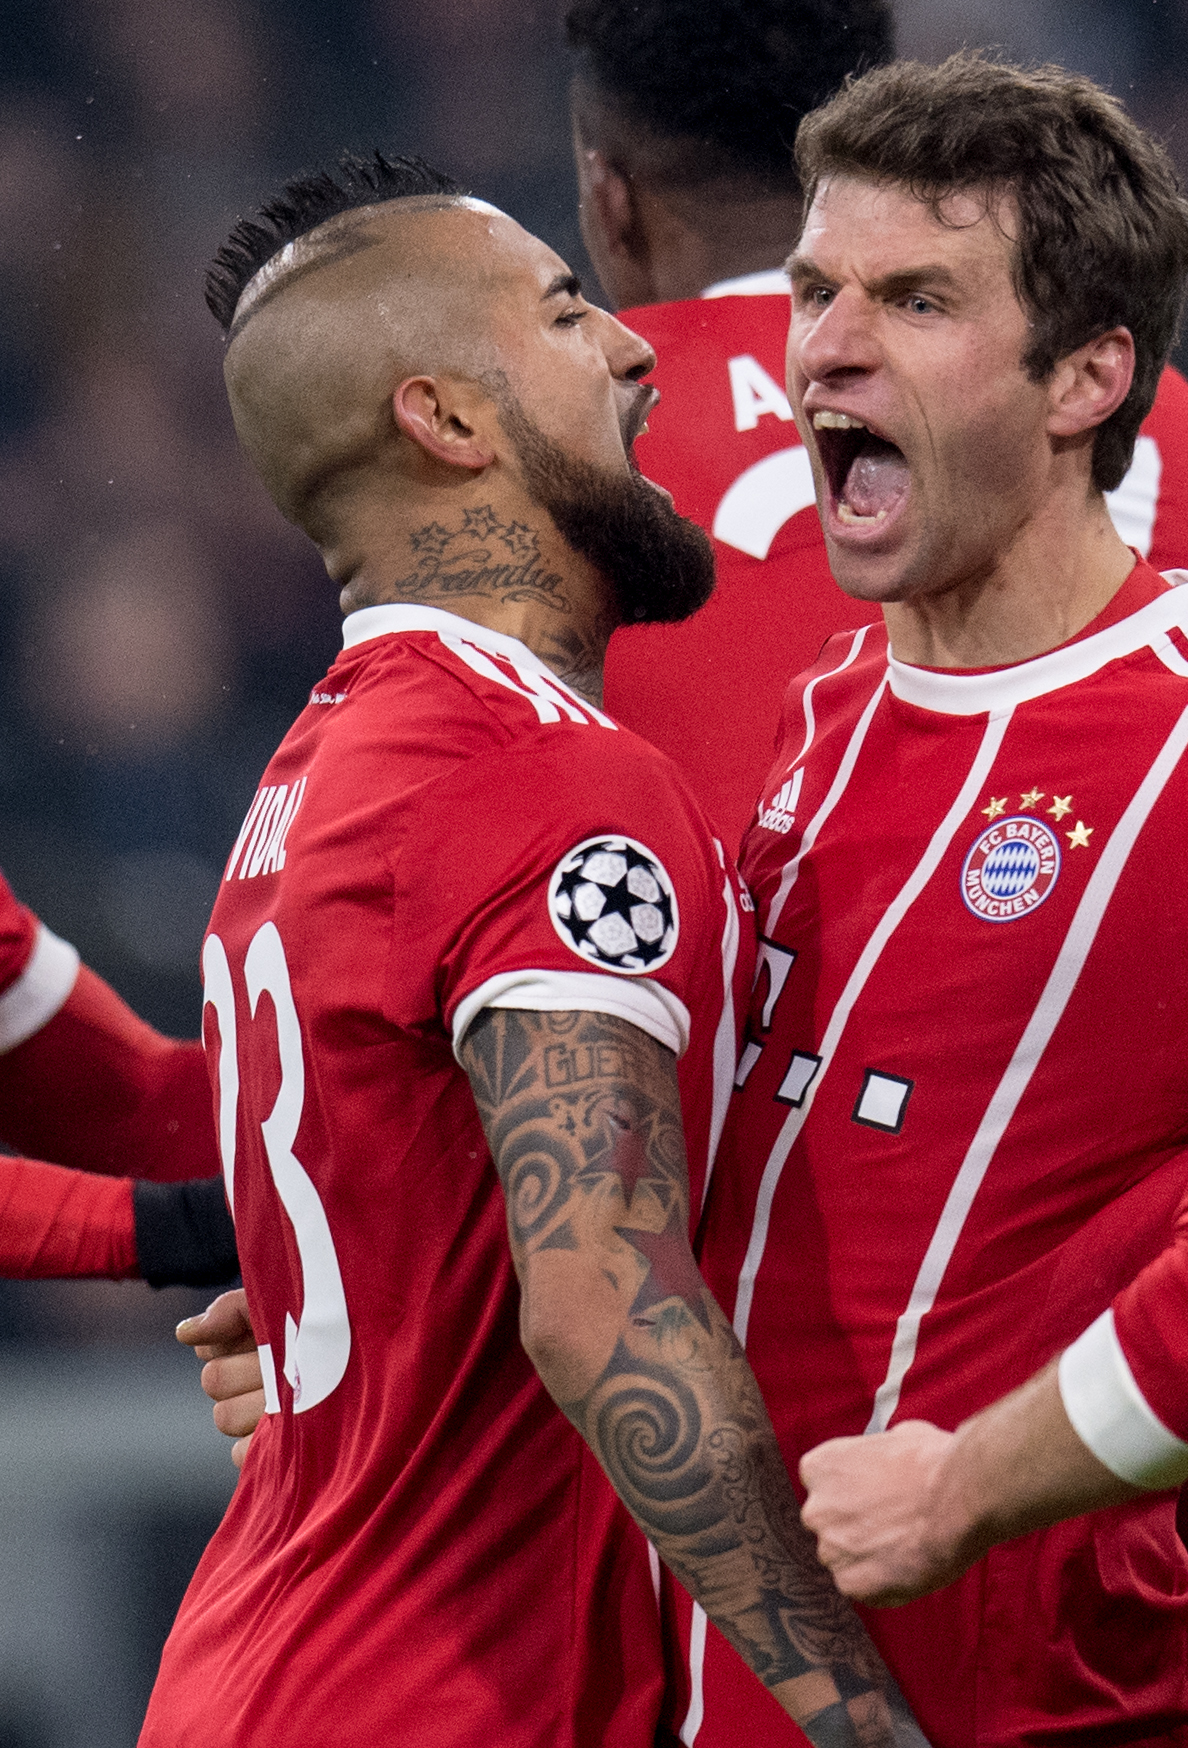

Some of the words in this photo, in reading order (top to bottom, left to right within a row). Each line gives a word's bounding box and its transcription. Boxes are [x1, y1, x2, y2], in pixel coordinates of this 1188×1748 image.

[225, 775, 308, 881] VIDAL
[979, 830, 1003, 855] FC
[1005, 823, 1055, 874] BAYERN
[201, 920, 352, 1415] 23
